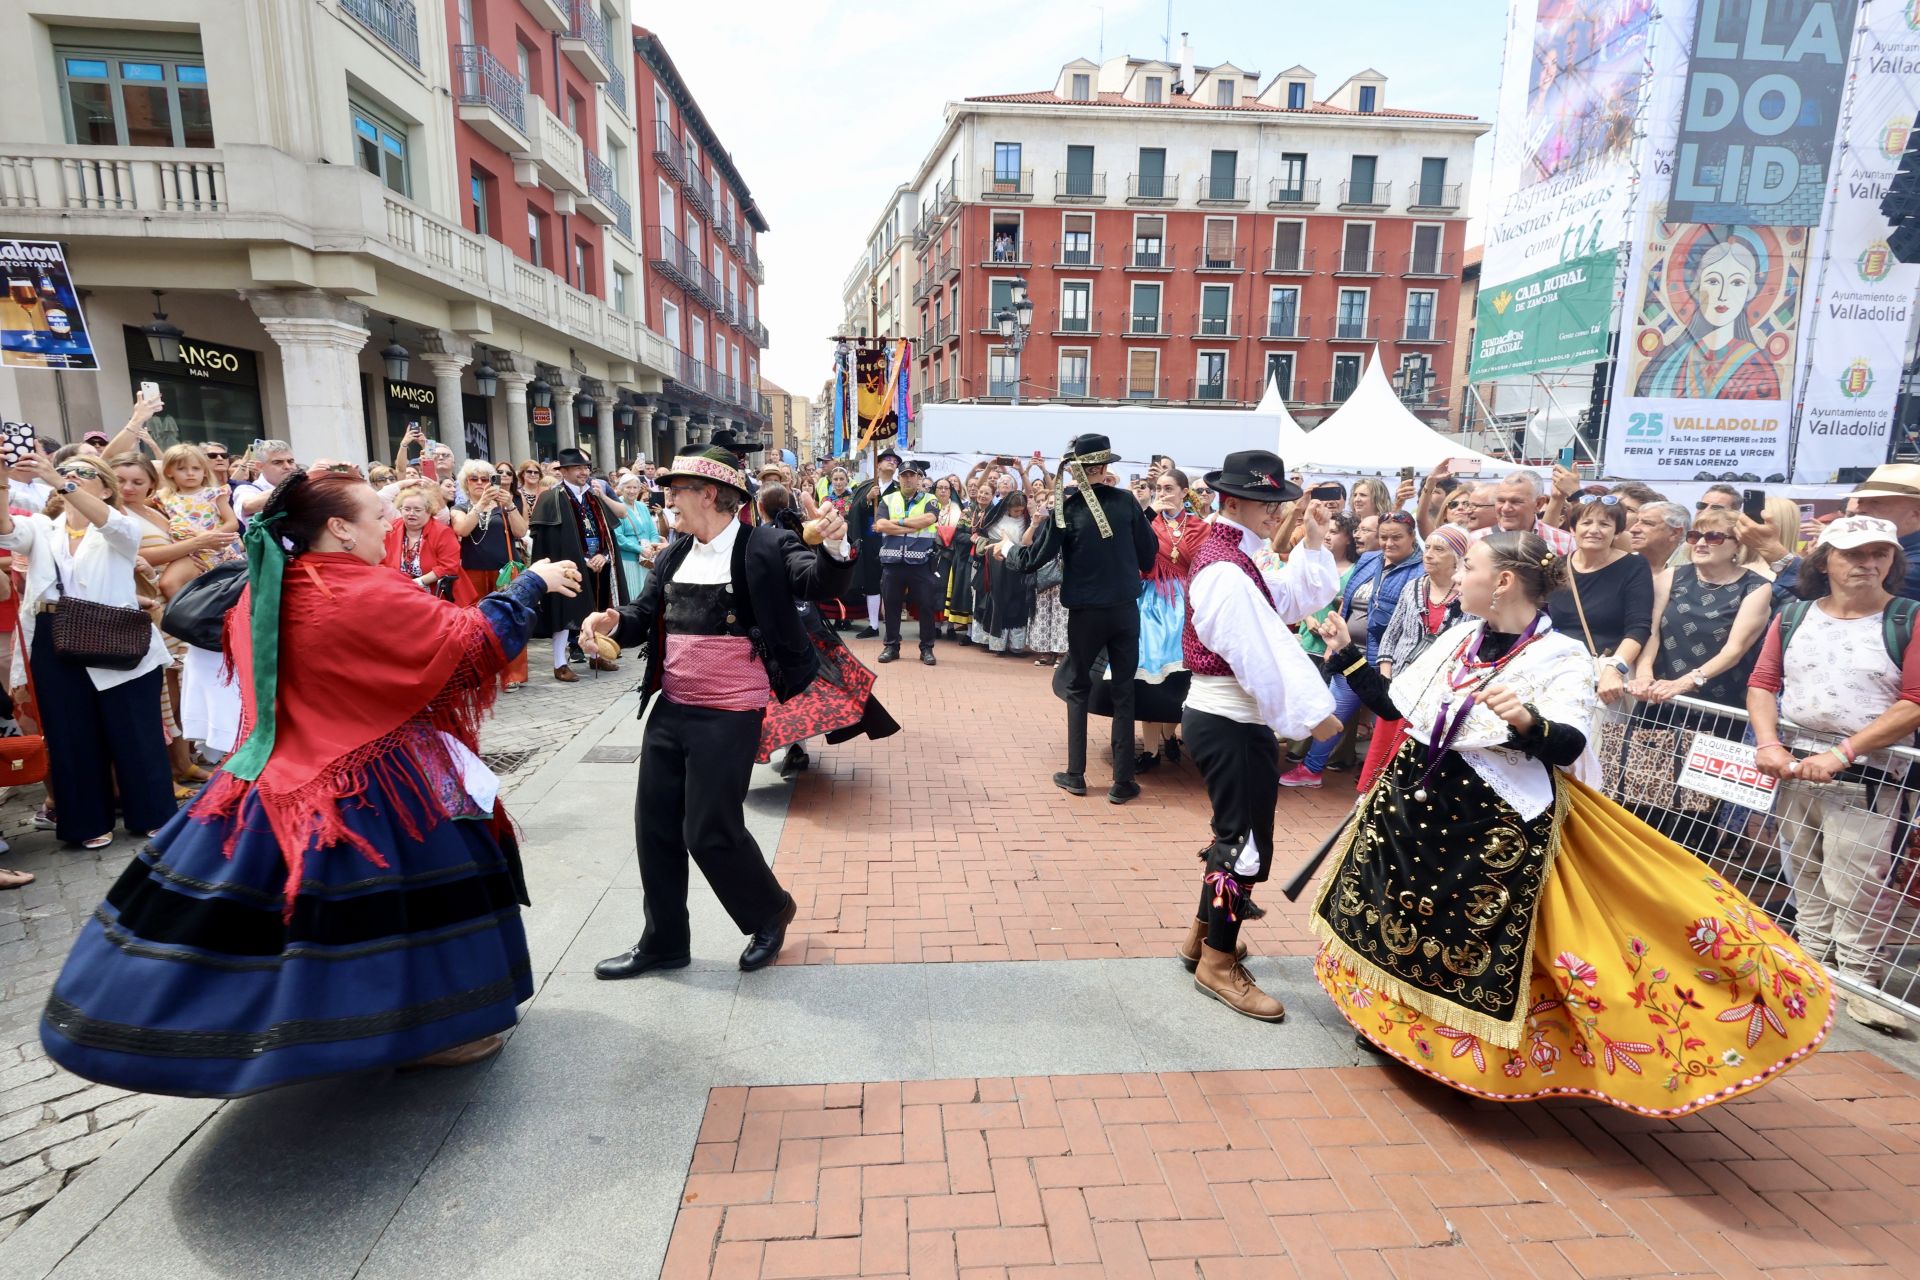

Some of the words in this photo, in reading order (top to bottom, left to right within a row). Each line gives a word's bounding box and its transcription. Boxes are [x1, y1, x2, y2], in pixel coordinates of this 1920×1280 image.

[1696, 0, 1843, 64] LLA
[1685, 72, 1801, 136] DO
[1675, 143, 1800, 205] LID
[1503, 162, 1600, 217] Disfrutando
[1489, 212, 1552, 247] Nuestras
[1558, 185, 1615, 221] Fiestas
[1525, 234, 1560, 258] como
[1560, 209, 1604, 267] tú
[0, 241, 63, 261] ahou
[1515, 282, 1541, 301] CAJA
[1543, 269, 1587, 293] RURAL
[1515, 302, 1526, 312] DE
[1527, 292, 1558, 308] ZAMORA
[1832, 291, 1895, 303] Ayuntamiento
[1830, 303, 1906, 322] Valladolid
[179, 344, 239, 372] ANGO
[1538, 354, 1570, 363] VALLADOLID
[189, 368, 209, 378] MAN
[390, 384, 435, 404] MANGO
[1810, 408, 1876, 417] Ayuntamiento
[1878, 410, 1888, 418] de
[1626, 412, 1663, 436] 25
[1673, 417, 1778, 431] VALLADOLID
[1809, 420, 1886, 436] Valladolid
[1701, 435, 1750, 443] SEPTIEMBRE
[1624, 447, 1653, 455] FERIA
[1669, 448, 1705, 456] FIESTAS
[1740, 449, 1775, 457] VIRGEN
[1673, 458, 1693, 466] SAN
[1846, 519, 1887, 532] NY
[1697, 738, 1742, 755] ALQUILER
[1705, 748, 1734, 760] EQUIPOS
[1690, 755, 1775, 788] BLAPE
